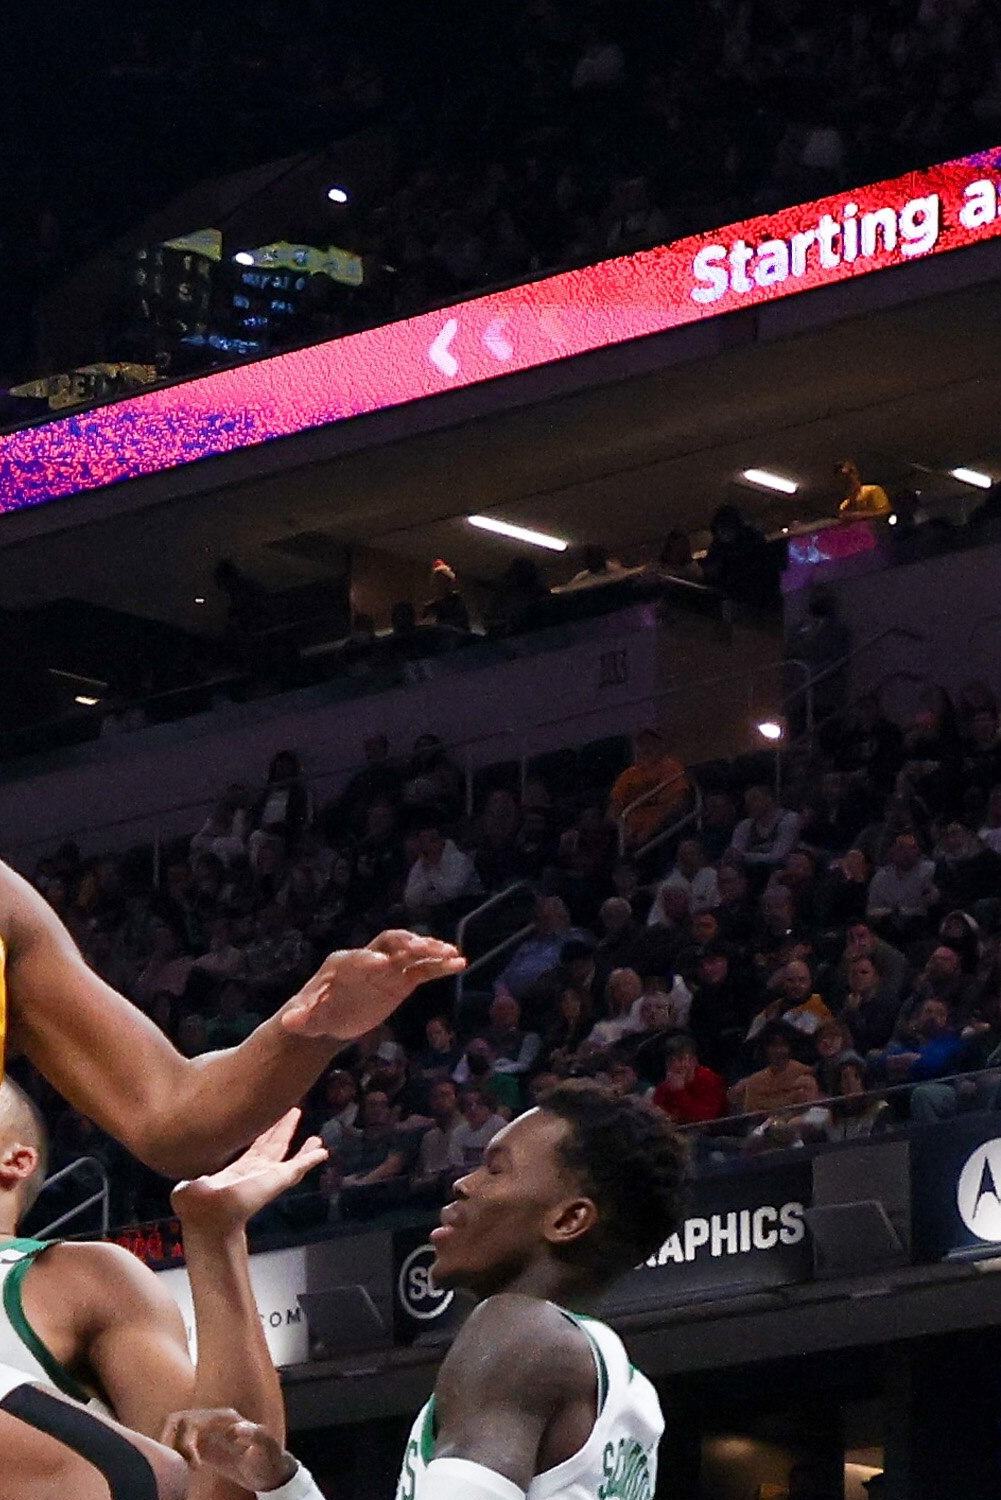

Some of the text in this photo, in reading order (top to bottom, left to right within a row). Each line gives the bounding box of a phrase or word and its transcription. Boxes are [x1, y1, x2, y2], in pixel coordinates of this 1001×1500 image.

[690, 178, 1001, 303] Starting a
[634, 1202, 805, 1270] APHICS
[261, 1308, 301, 1328] OM
